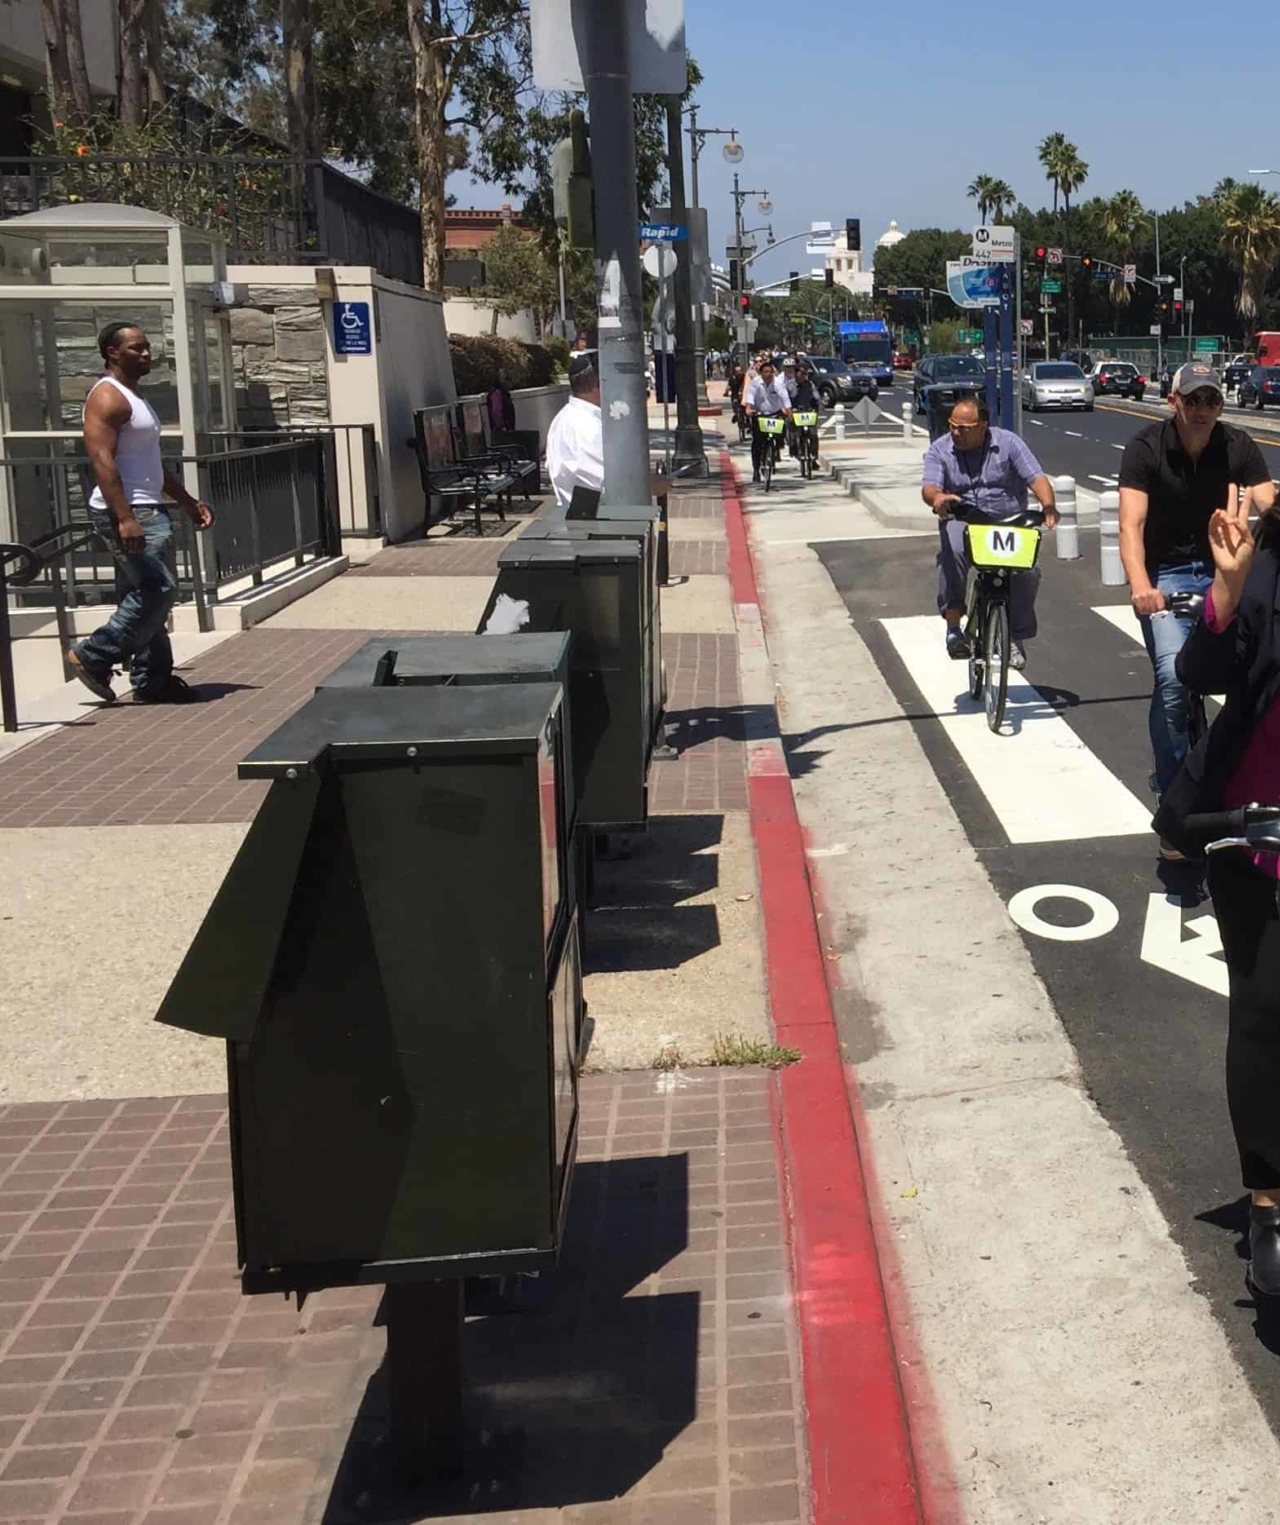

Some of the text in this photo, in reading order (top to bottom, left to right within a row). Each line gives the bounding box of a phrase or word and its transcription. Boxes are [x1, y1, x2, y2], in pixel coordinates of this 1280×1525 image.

[641, 225, 679, 238] Rapid
[977, 230, 989, 241] M
[976, 251, 991, 259] 442
[993, 531, 1015, 551] M
